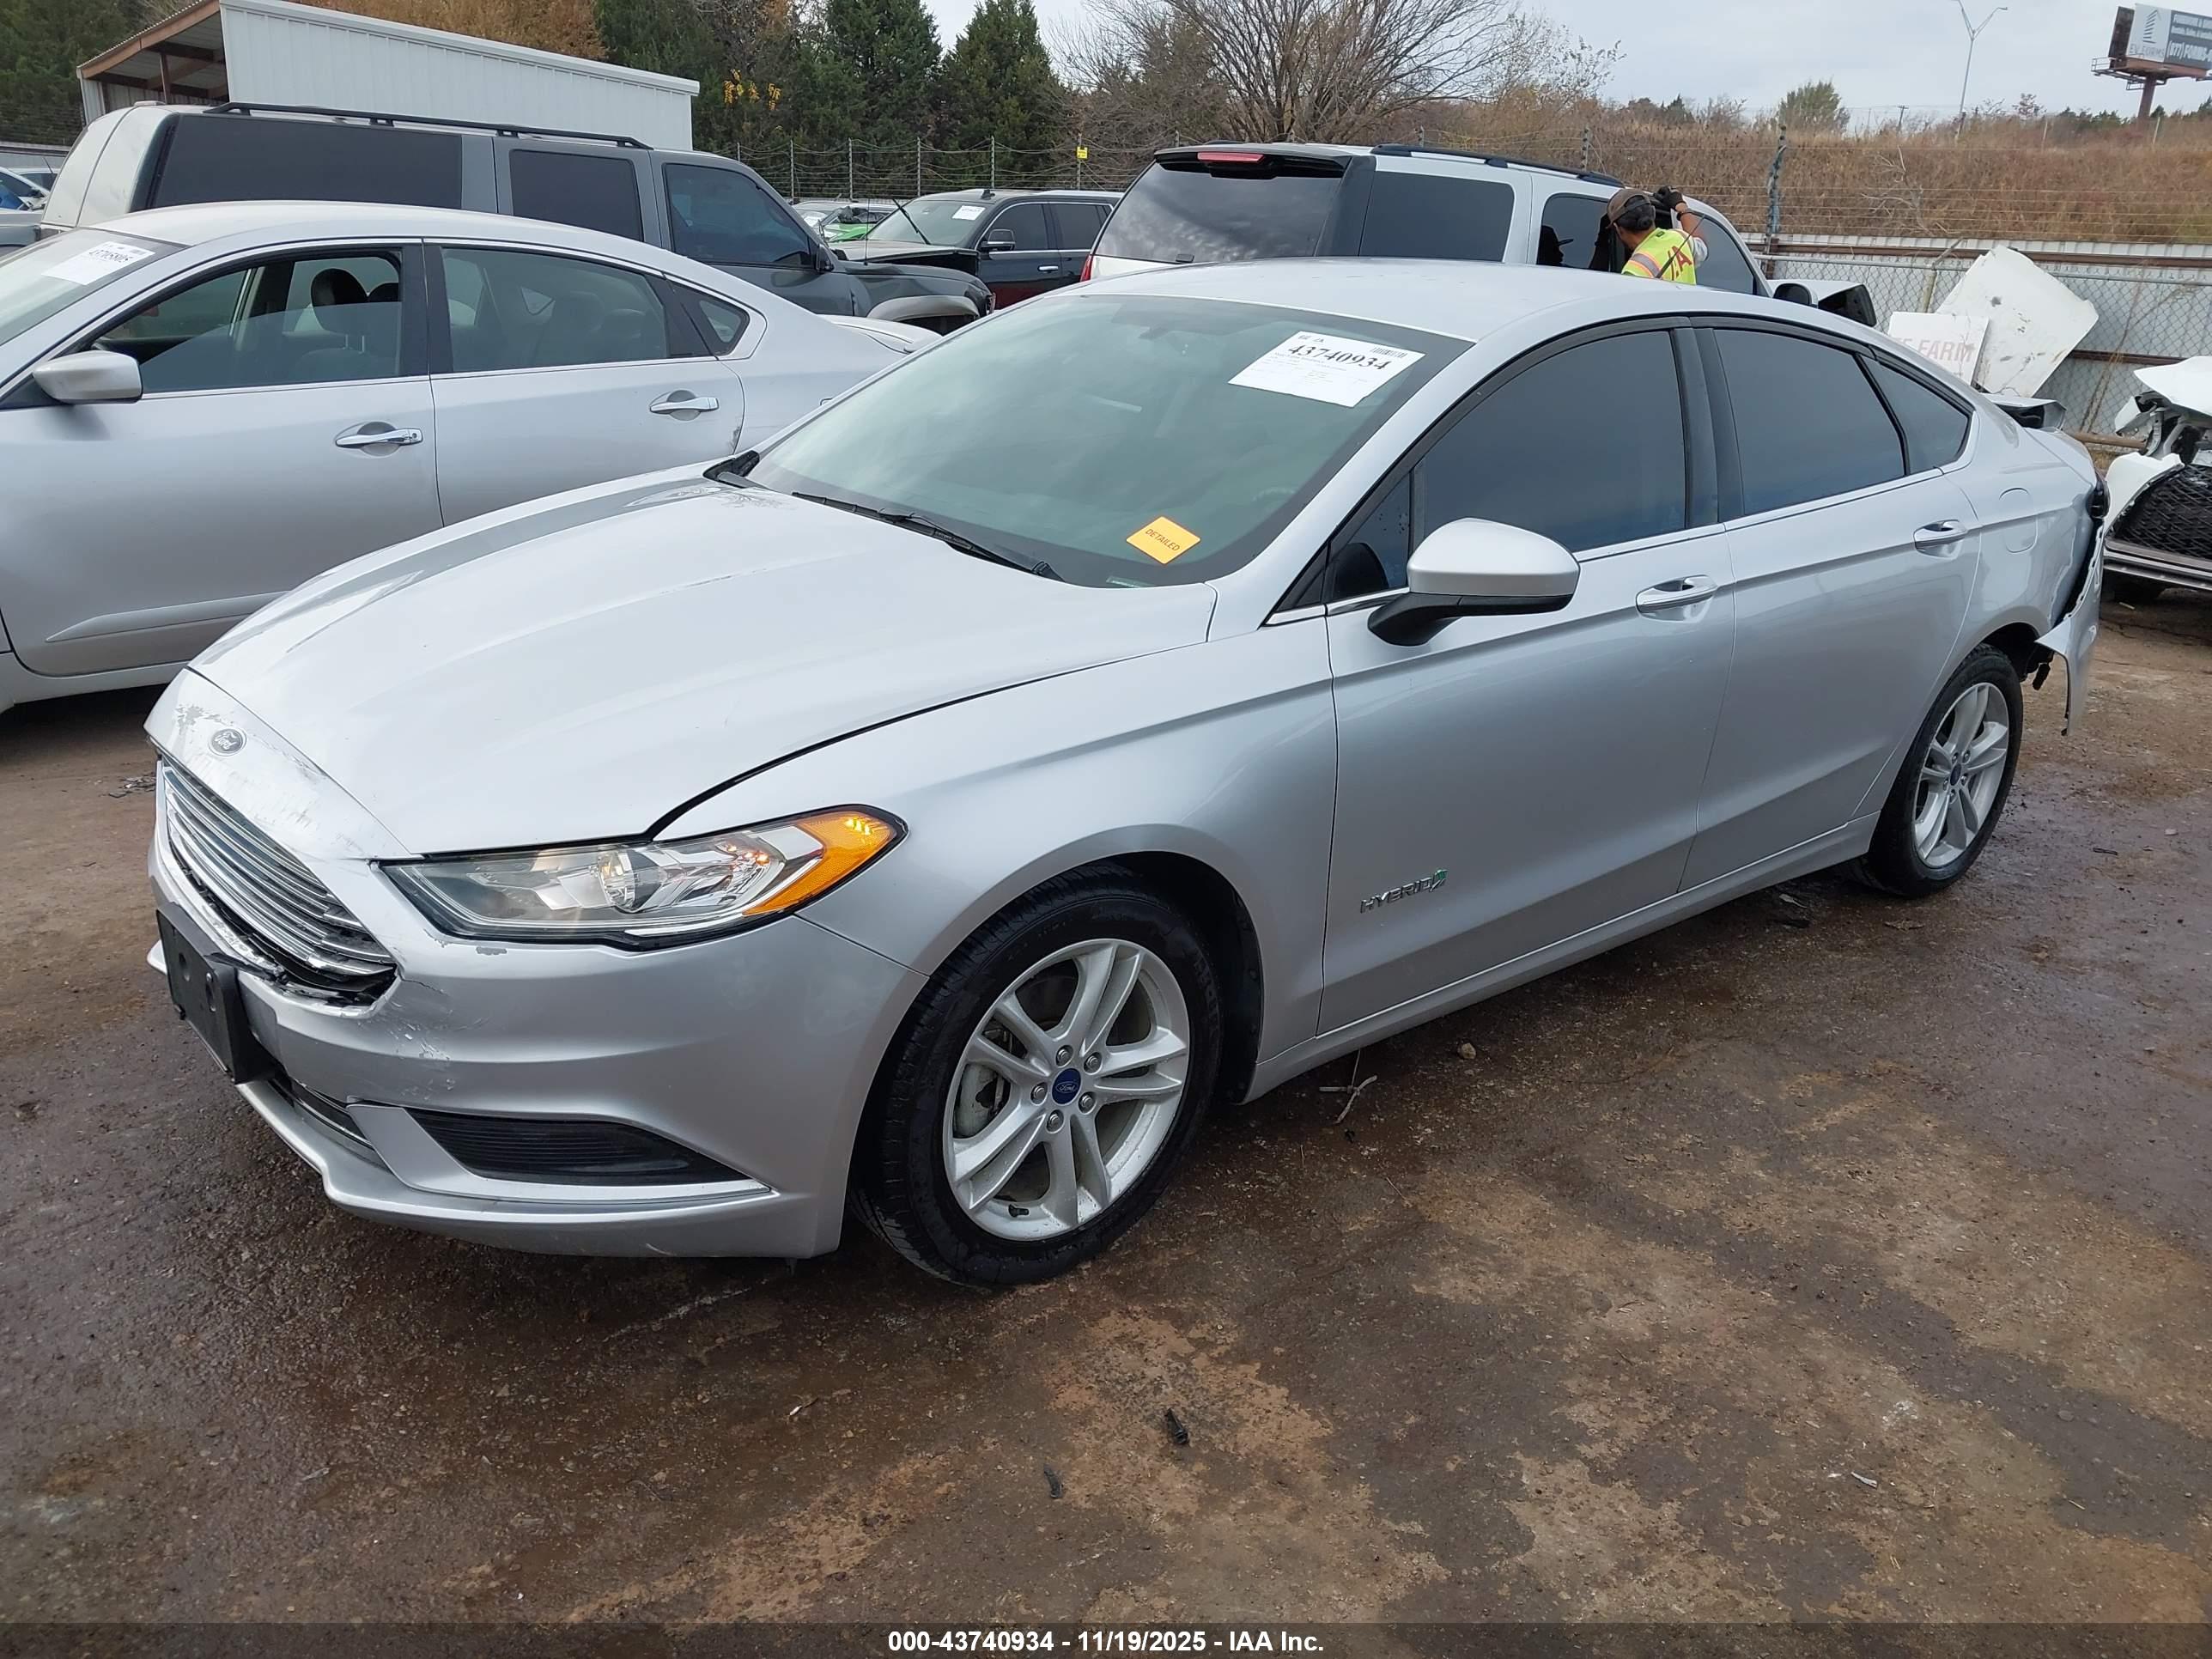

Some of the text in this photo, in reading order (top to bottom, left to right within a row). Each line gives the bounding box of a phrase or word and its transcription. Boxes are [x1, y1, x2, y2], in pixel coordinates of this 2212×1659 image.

[1288, 344, 1393, 370] 43740934
[1917, 338, 1976, 362] FARM
[1145, 528, 1181, 551] DETAILED
[215, 732, 238, 750] Ford
[1359, 876, 1433, 914] HYBRID
